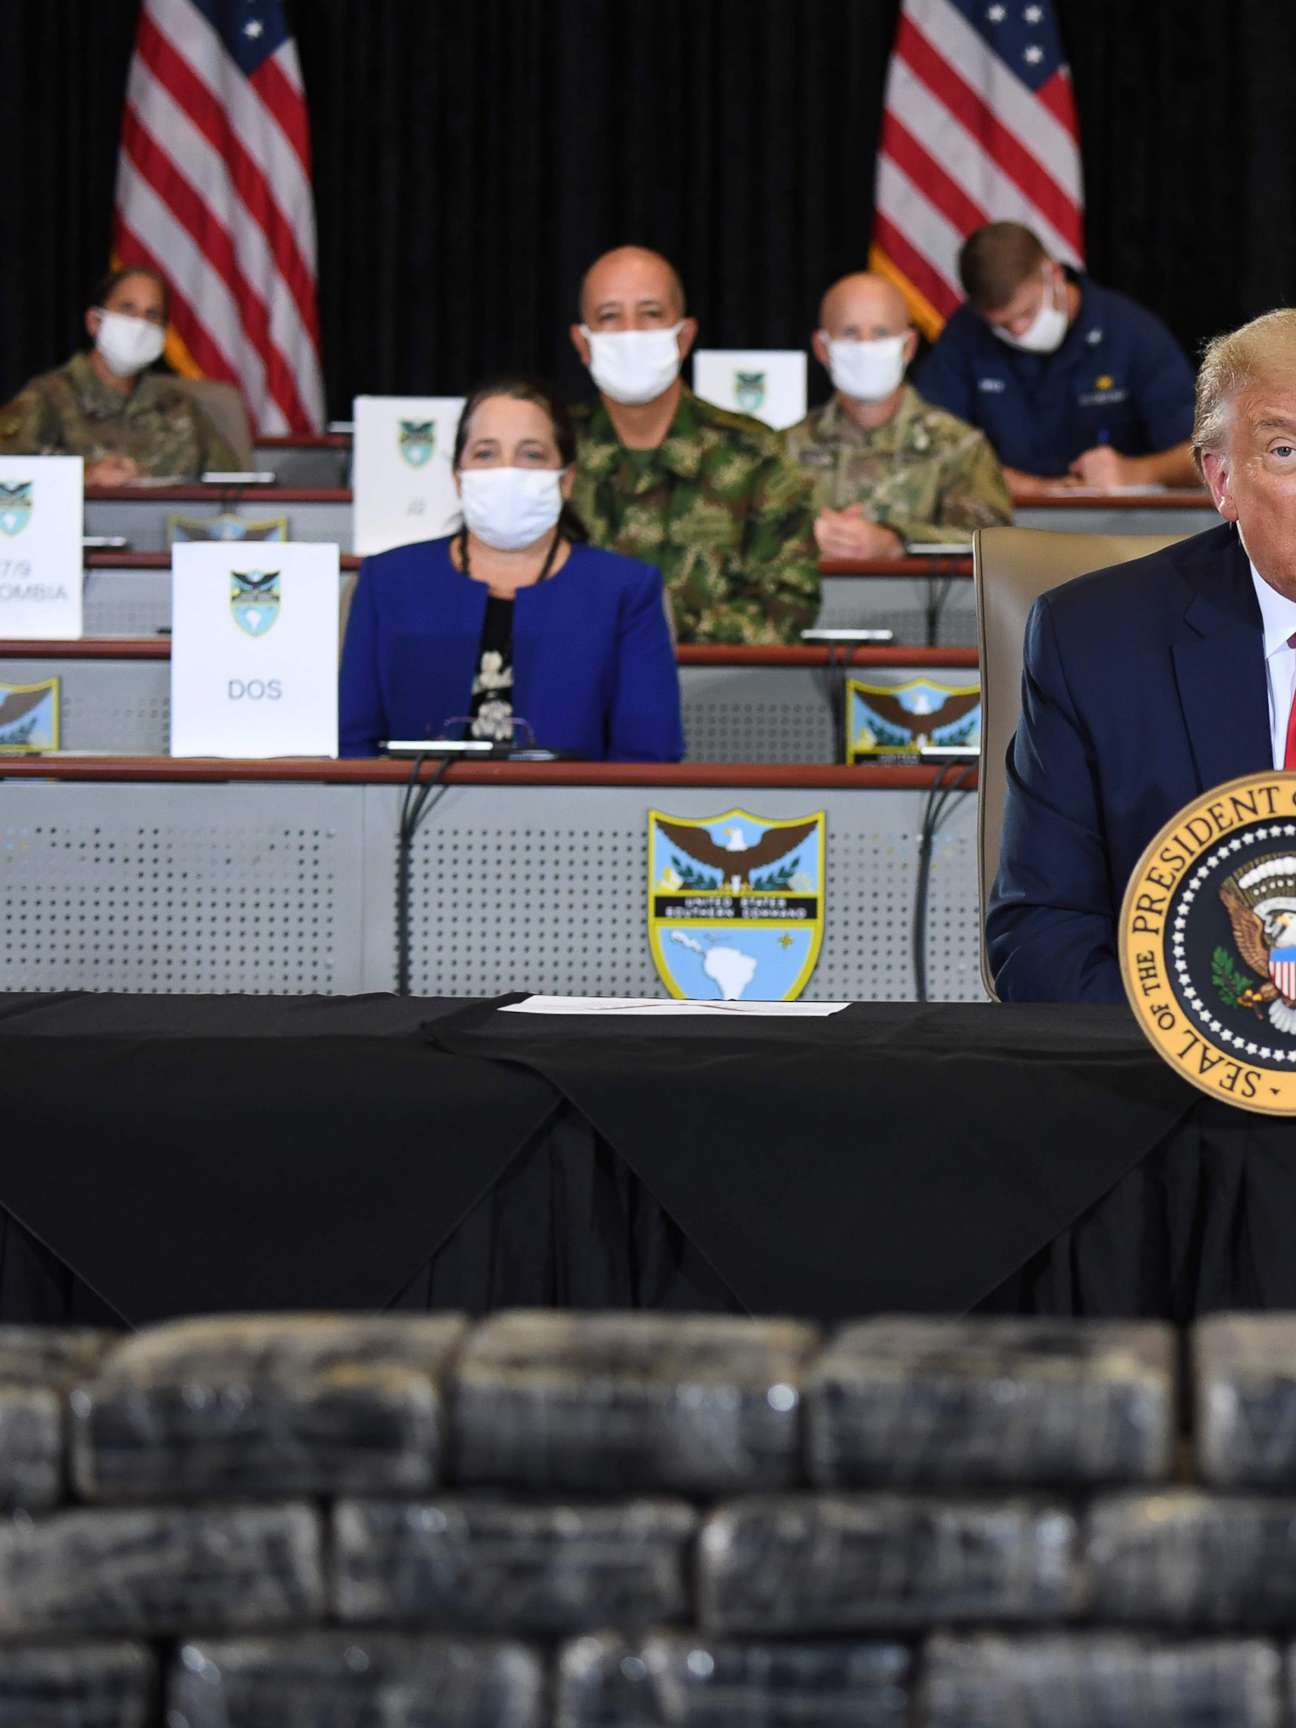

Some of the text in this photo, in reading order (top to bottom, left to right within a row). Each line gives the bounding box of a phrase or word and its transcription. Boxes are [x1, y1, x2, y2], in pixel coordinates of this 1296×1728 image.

[228, 679, 283, 700] DOS
[1132, 786, 1281, 936] PRESIDENT
[665, 907, 807, 918] SOUTHERN COMMAND
[685, 897, 786, 907] UNITED STATES
[1136, 949, 1160, 996] THE
[1150, 1002, 1176, 1031] OF
[1176, 1028, 1262, 1098] SEAL
